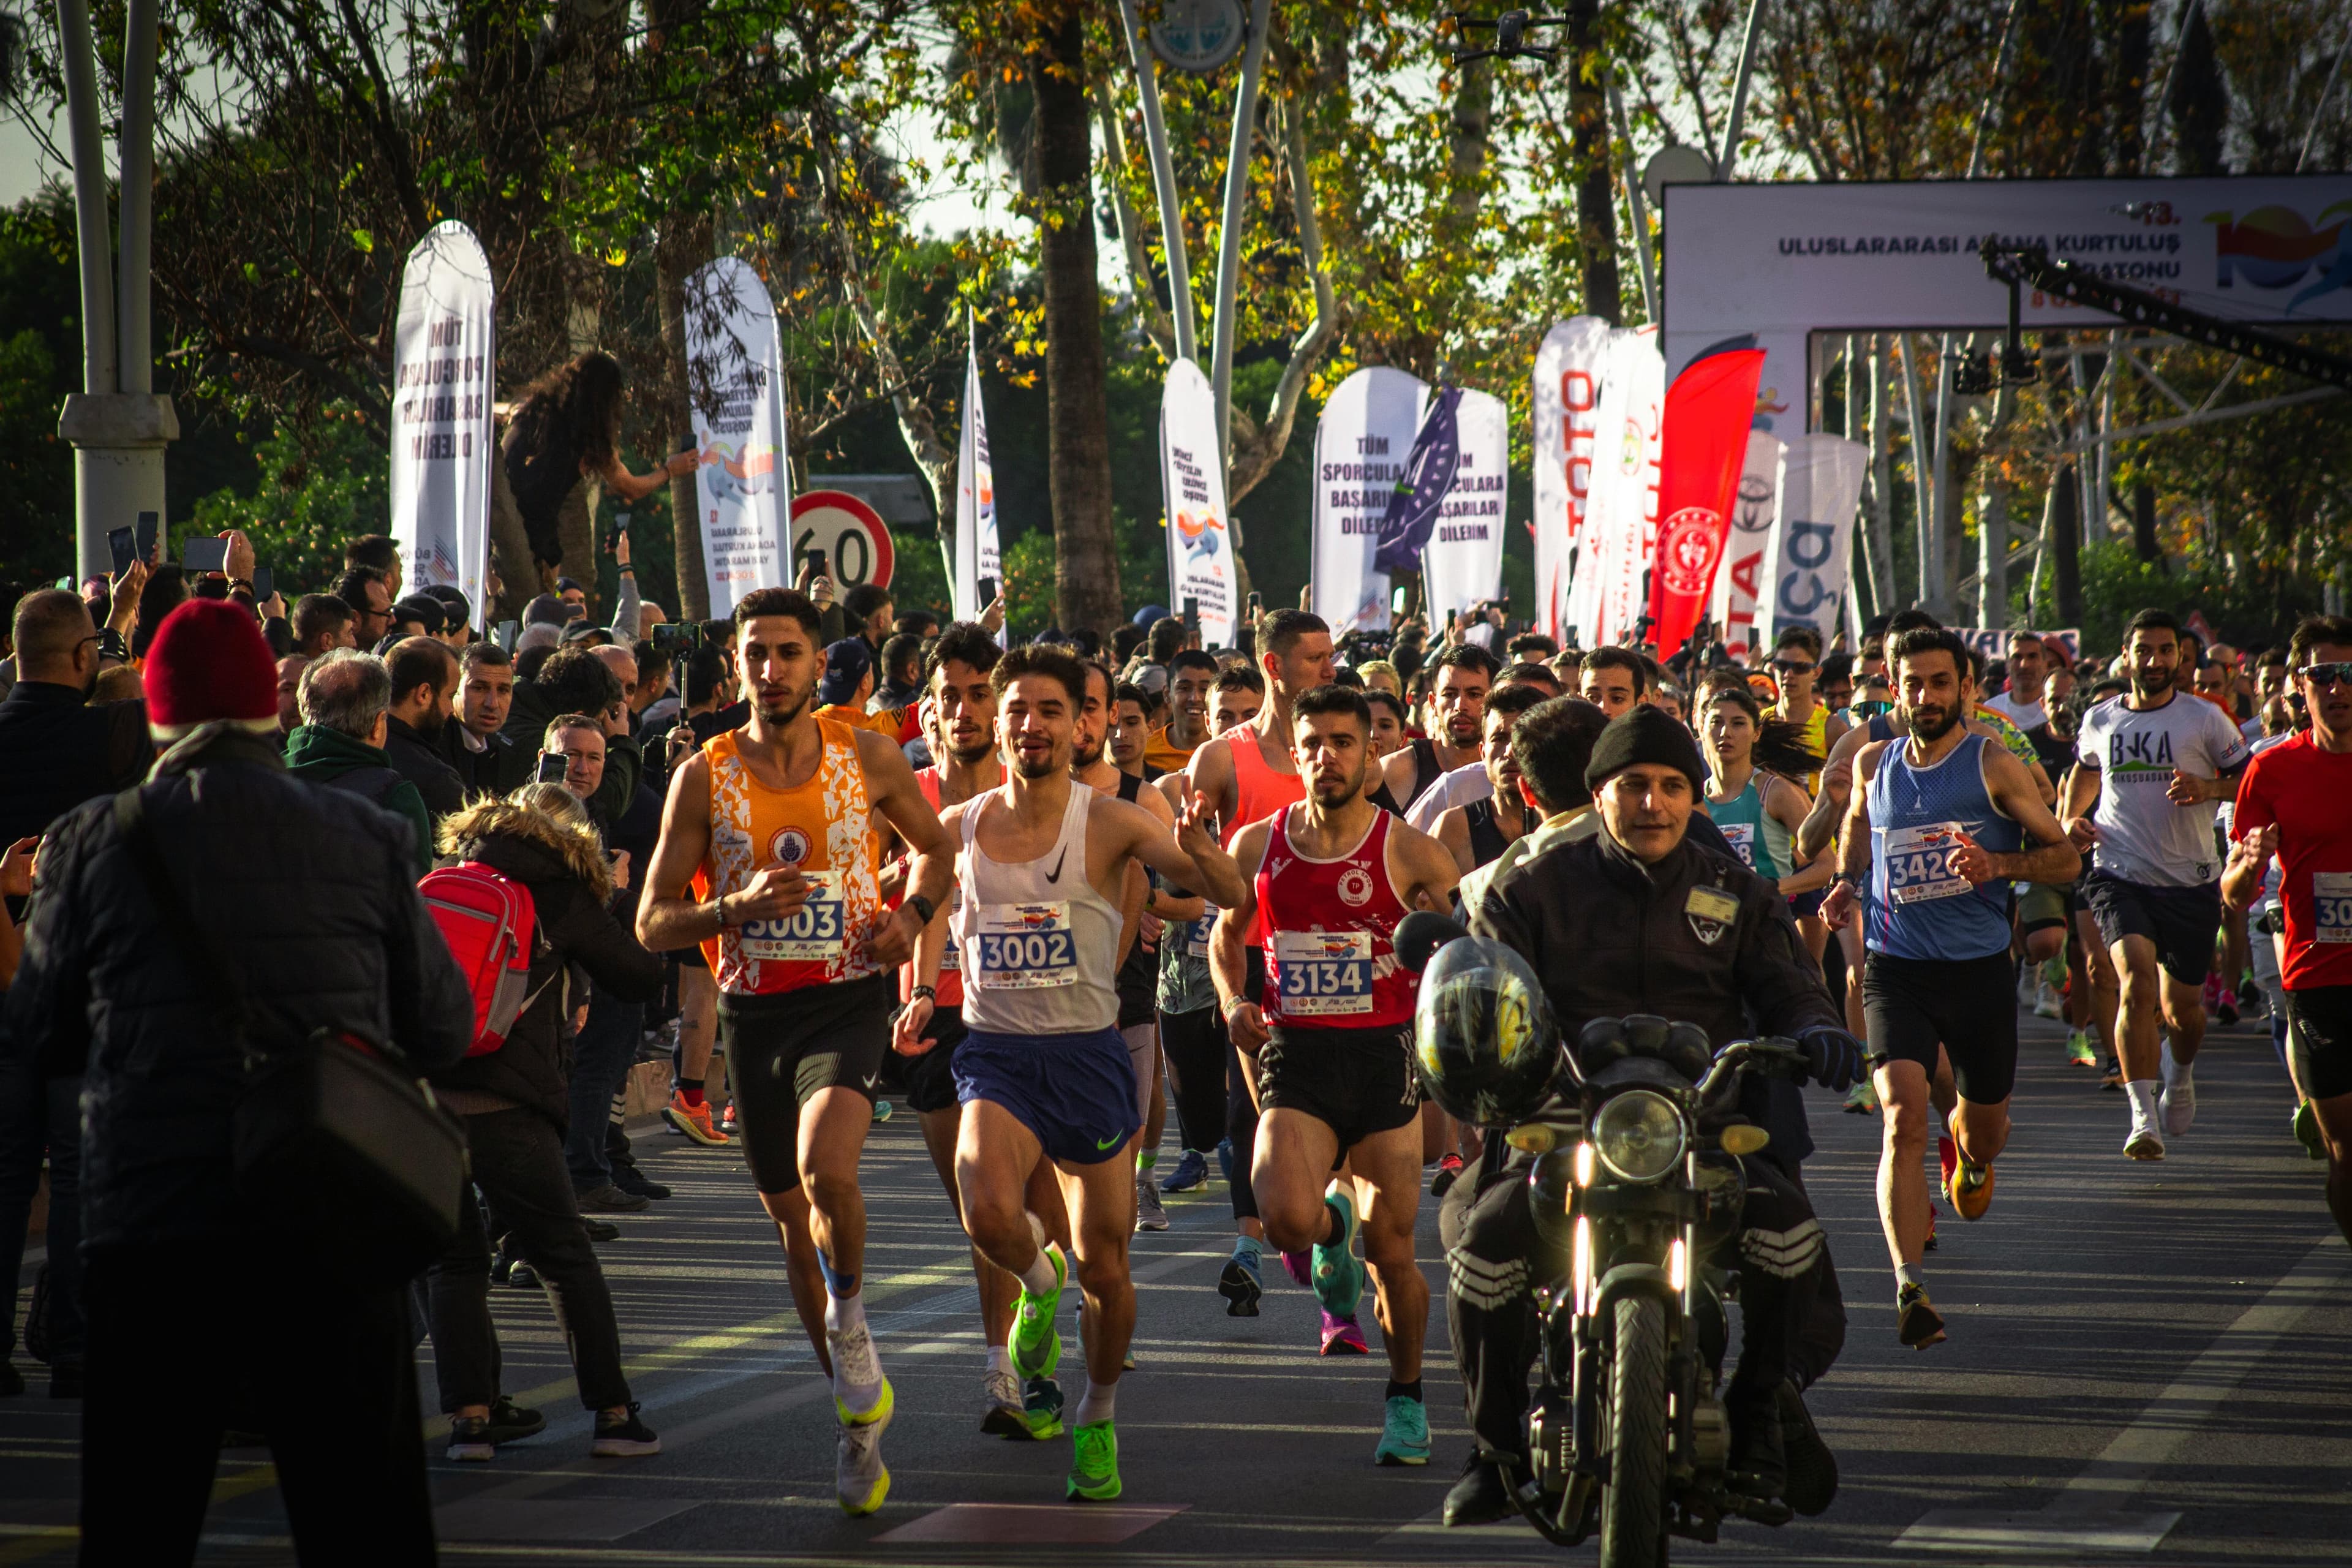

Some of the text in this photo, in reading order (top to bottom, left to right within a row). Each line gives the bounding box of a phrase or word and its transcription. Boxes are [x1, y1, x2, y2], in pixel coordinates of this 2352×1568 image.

[1778, 234, 2180, 255] ULUSLARARASI AANA KURTULUŞ
[1357, 434, 1389, 454] TÜM
[1323, 463, 1401, 481] SPORCULA
[1331, 490, 1388, 510] BAŞARI
[1341, 513, 1384, 534] DİLE
[1339, 870, 1372, 888] PETROL SPOR
[2320, 899, 2352, 926] 30
[984, 933, 1070, 969] 3002
[1287, 962, 1362, 995] 3134
